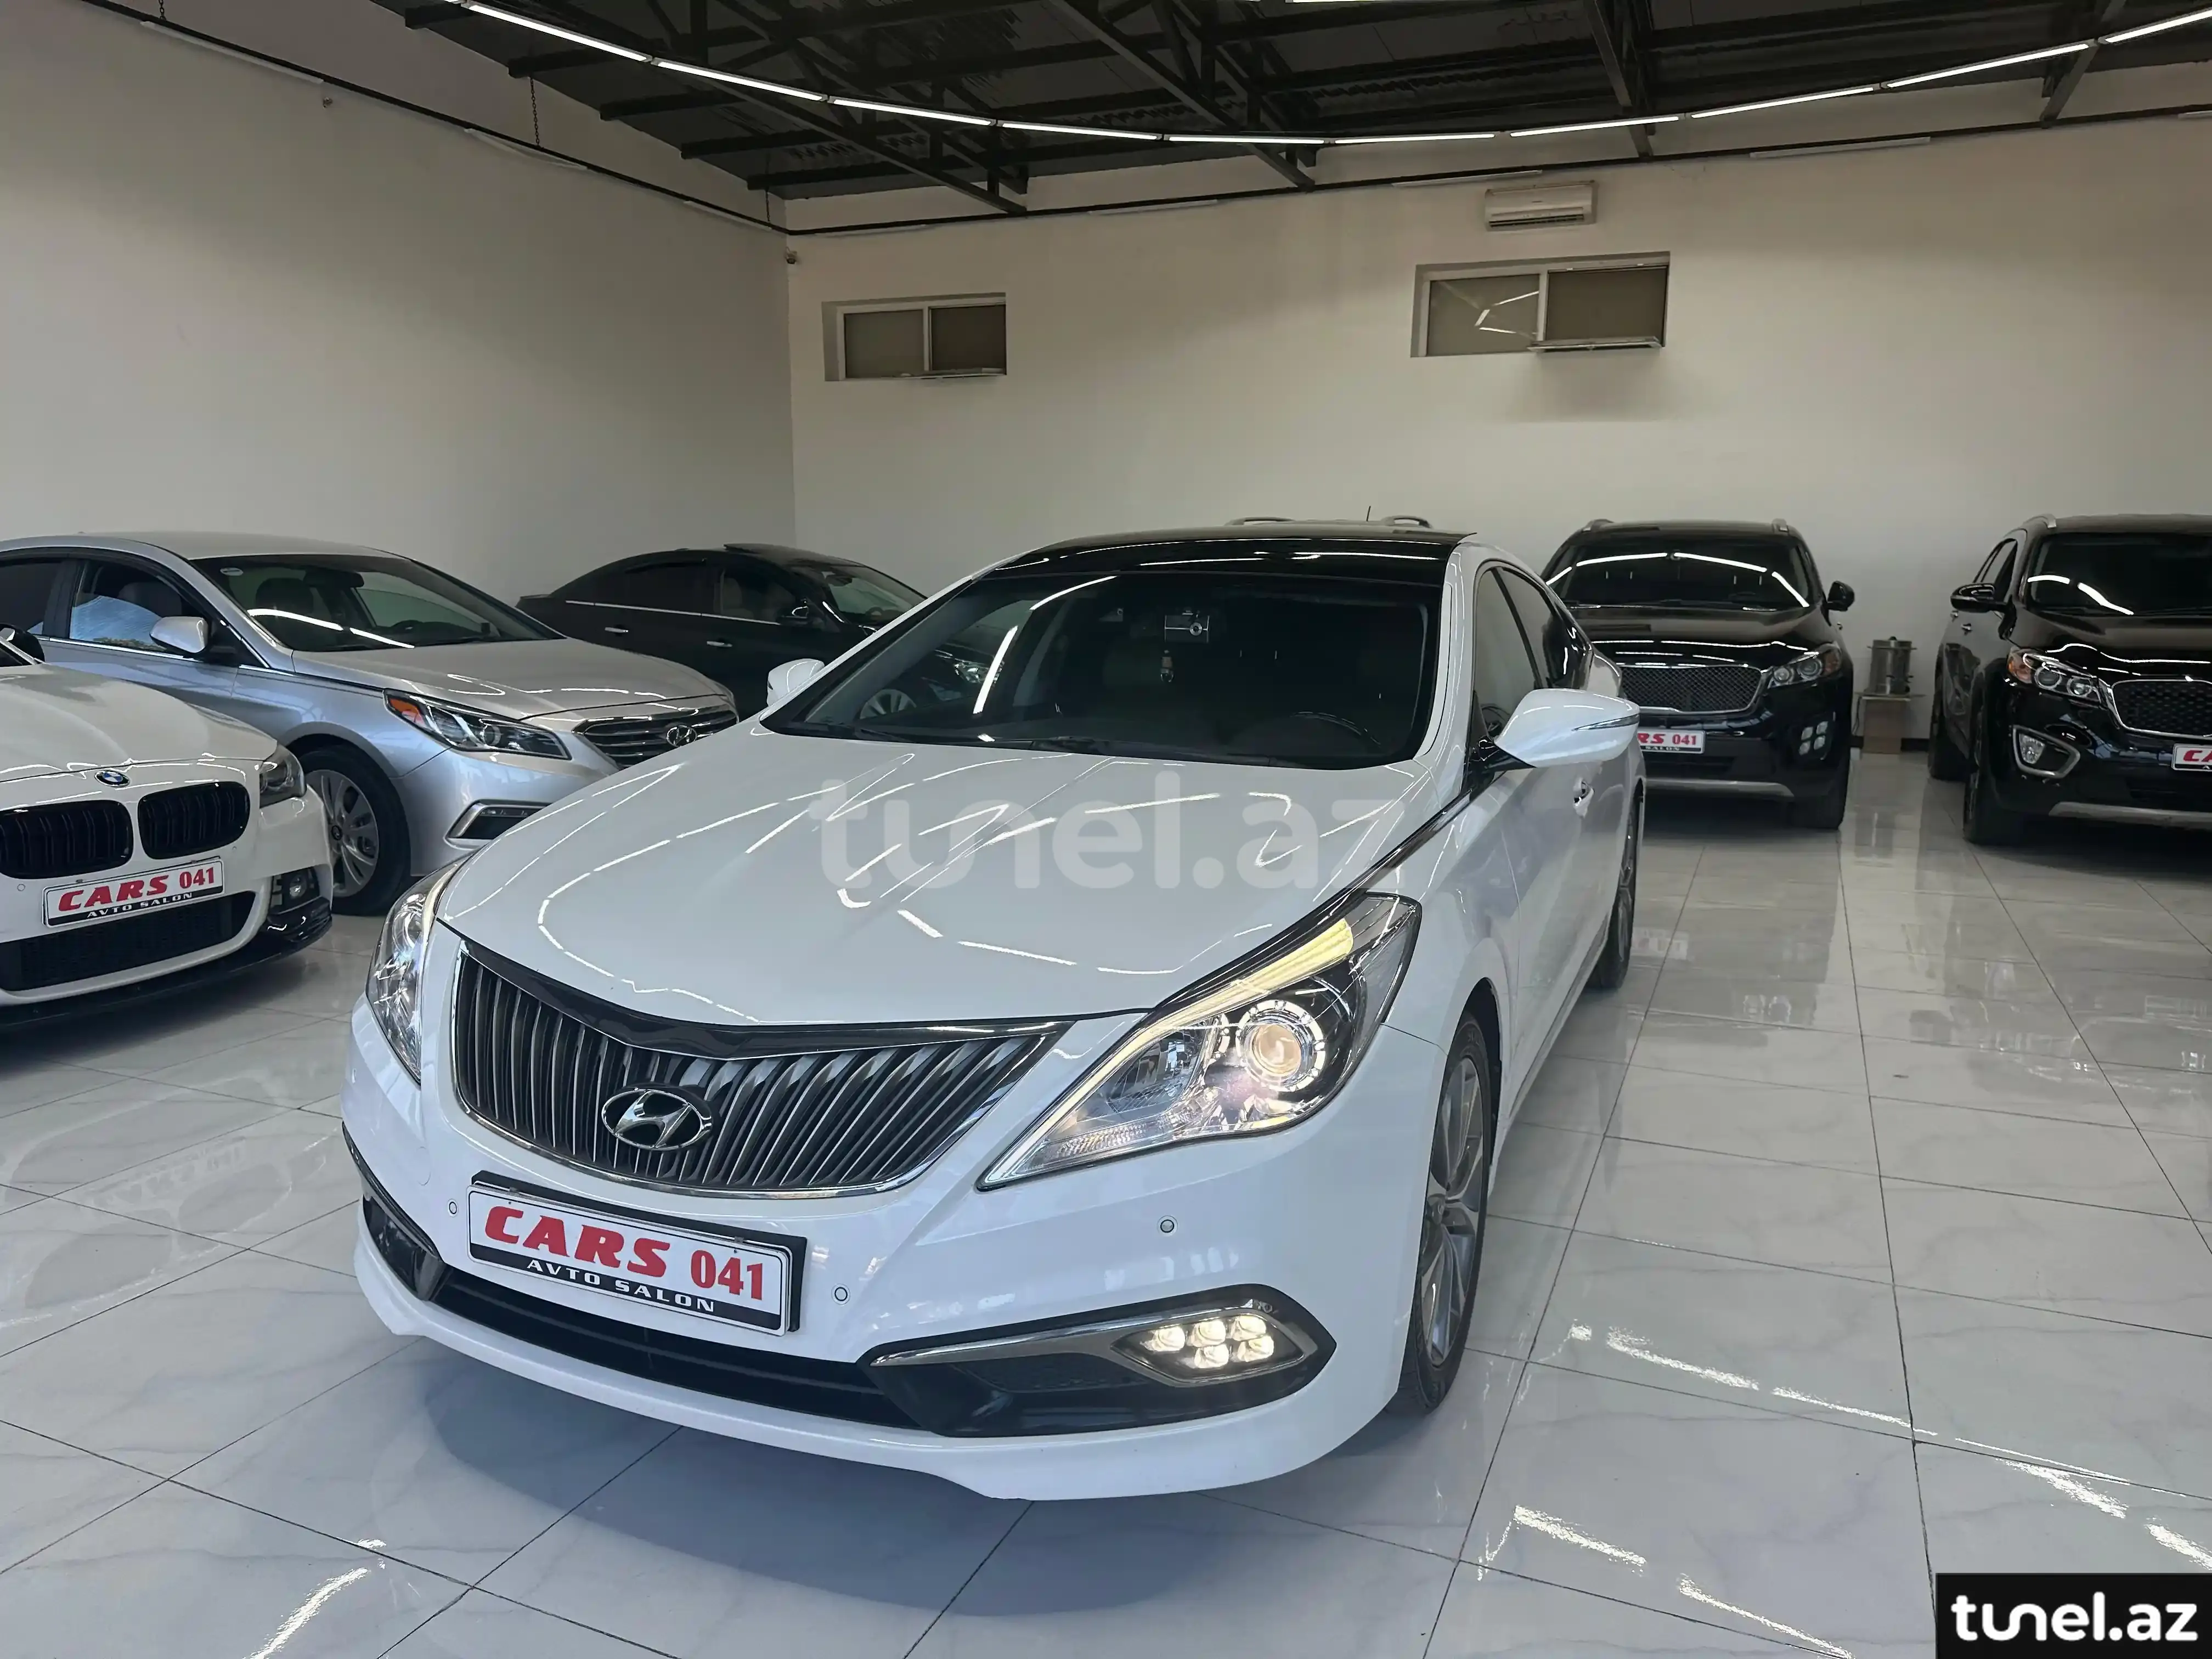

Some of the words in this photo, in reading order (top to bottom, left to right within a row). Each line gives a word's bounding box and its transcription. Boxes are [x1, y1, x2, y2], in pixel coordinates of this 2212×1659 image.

[1637, 733, 1666, 744] RS
[1672, 733, 1696, 745] 041
[58, 875, 168, 911] CARS
[179, 867, 214, 889] 041
[87, 905, 132, 918] AVTO
[140, 892, 193, 907] SALON
[484, 1206, 670, 1277] CARS
[691, 1250, 763, 1301] 041
[527, 1259, 601, 1286] AVTO
[615, 1280, 714, 1312] SALON
